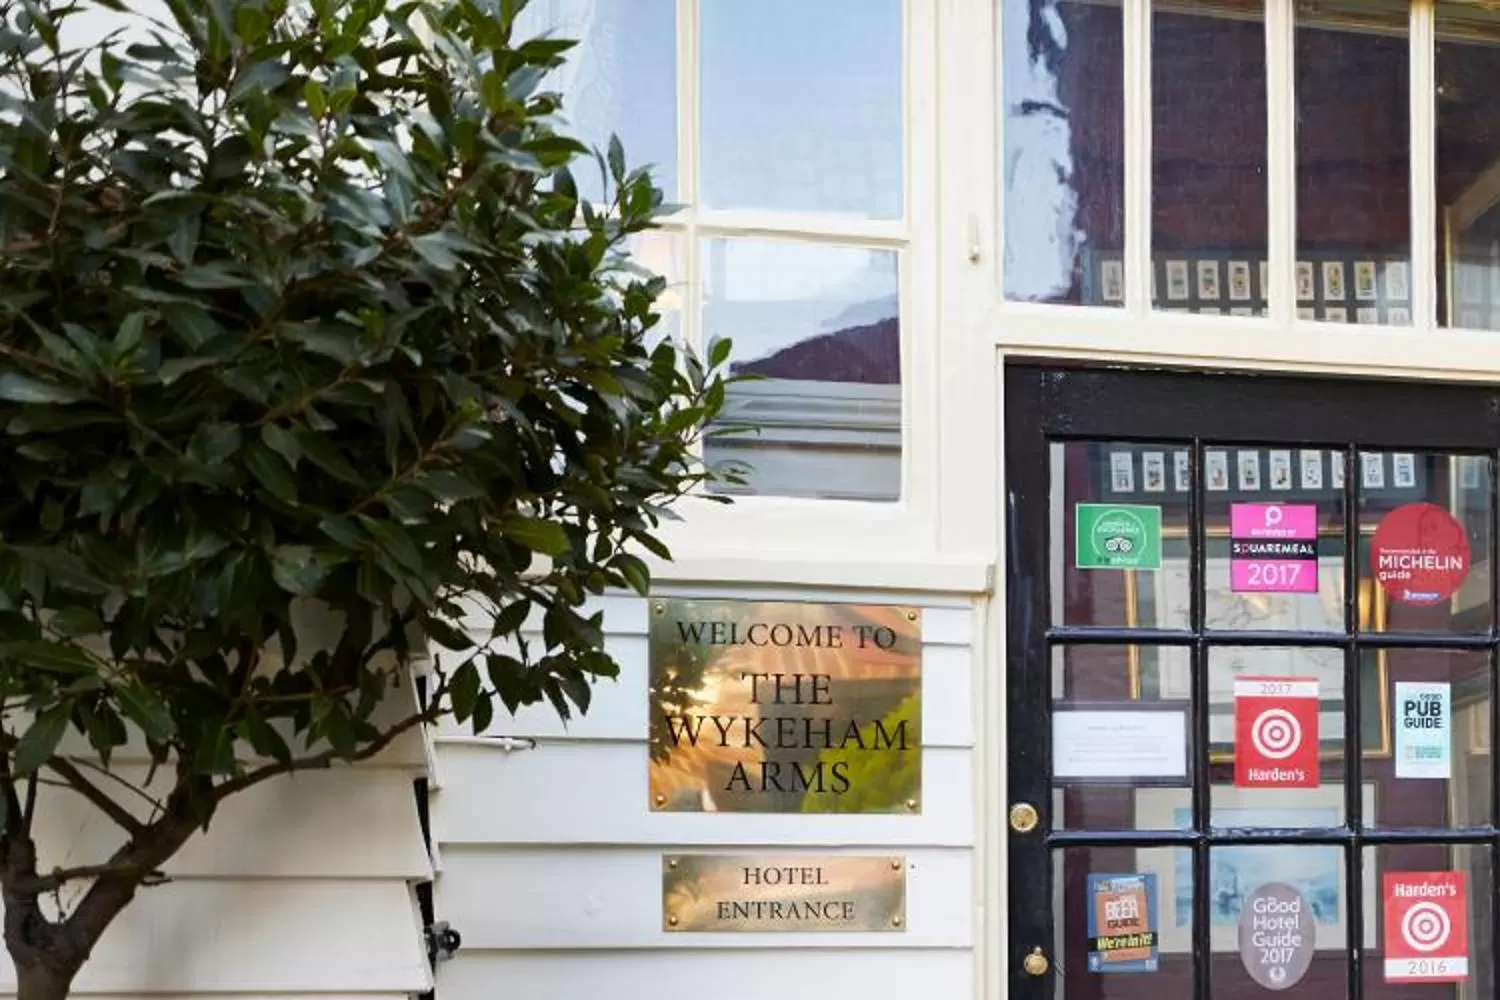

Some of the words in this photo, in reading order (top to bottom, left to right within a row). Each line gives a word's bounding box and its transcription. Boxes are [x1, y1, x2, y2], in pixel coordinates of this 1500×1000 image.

[1379, 555, 1463, 570] MICHELIN
[1247, 563, 1302, 585] 2017
[1379, 570, 1411, 580] guide
[676, 621, 843, 648] WELCOME
[852, 625, 897, 650] TO
[741, 672, 834, 706] THE
[1261, 683, 1292, 694] 2017
[1404, 700, 1442, 716] PUB
[1403, 717, 1444, 729] GUIDE
[665, 715, 910, 751] WYKEHAM
[725, 760, 851, 794] ARMS
[1248, 767, 1306, 781] Harden's
[743, 866, 829, 885] HOTEL
[1394, 881, 1457, 897] Harden's
[716, 900, 856, 921] ENTRANCE
[1253, 896, 1301, 914] Good
[1253, 914, 1300, 930] Hotel
[1252, 928, 1303, 947] Guide
[1260, 947, 1295, 964] 2017
[1407, 960, 1448, 975] 2016
